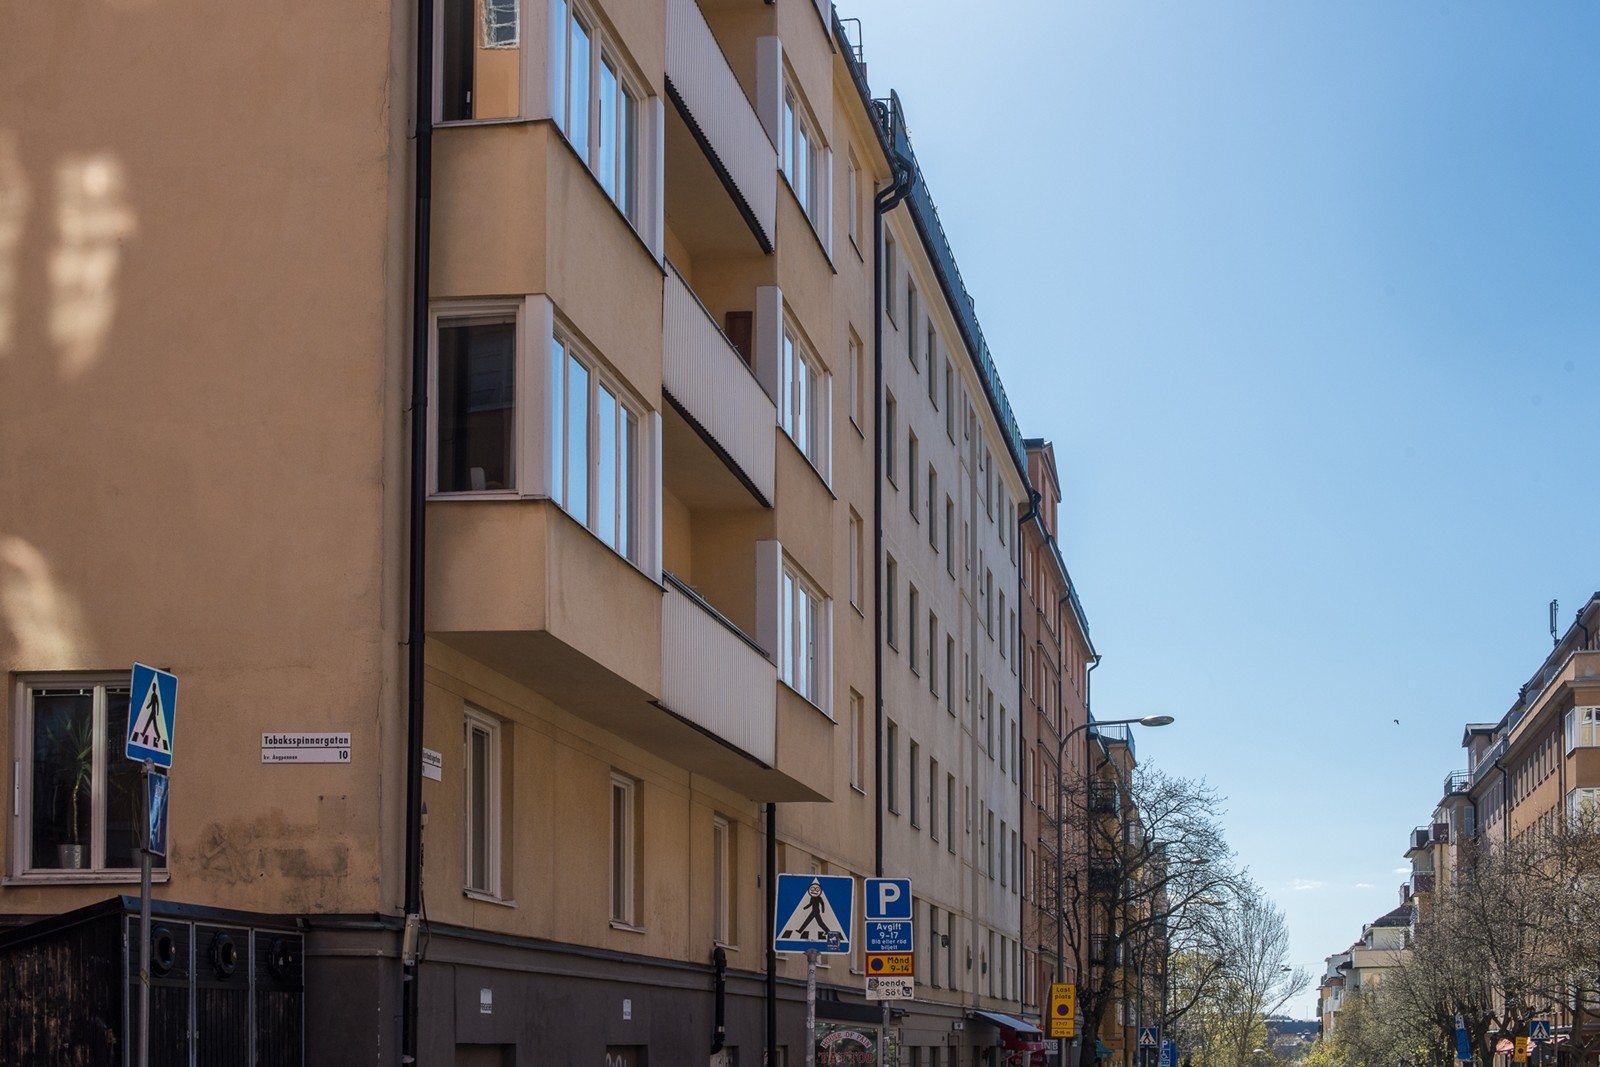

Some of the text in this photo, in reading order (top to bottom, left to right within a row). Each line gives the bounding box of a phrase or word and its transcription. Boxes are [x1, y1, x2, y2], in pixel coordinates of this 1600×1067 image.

[264, 735, 348, 747] Tobaksspinnargatan
[339, 751, 348, 759] 10
[879, 883, 900, 915] P
[876, 923, 902, 932] Avgift
[879, 931, 899, 939] 9-17
[887, 956, 910, 964] Månd
[890, 964, 909, 972] 9-14
[880, 979, 906, 987] oende
[821, 1032, 842, 1048] HOUSE
[856, 1034, 871, 1048] PAIN
[1162, 1040, 1169, 1048] P
[818, 1051, 874, 1065] TATTOO
